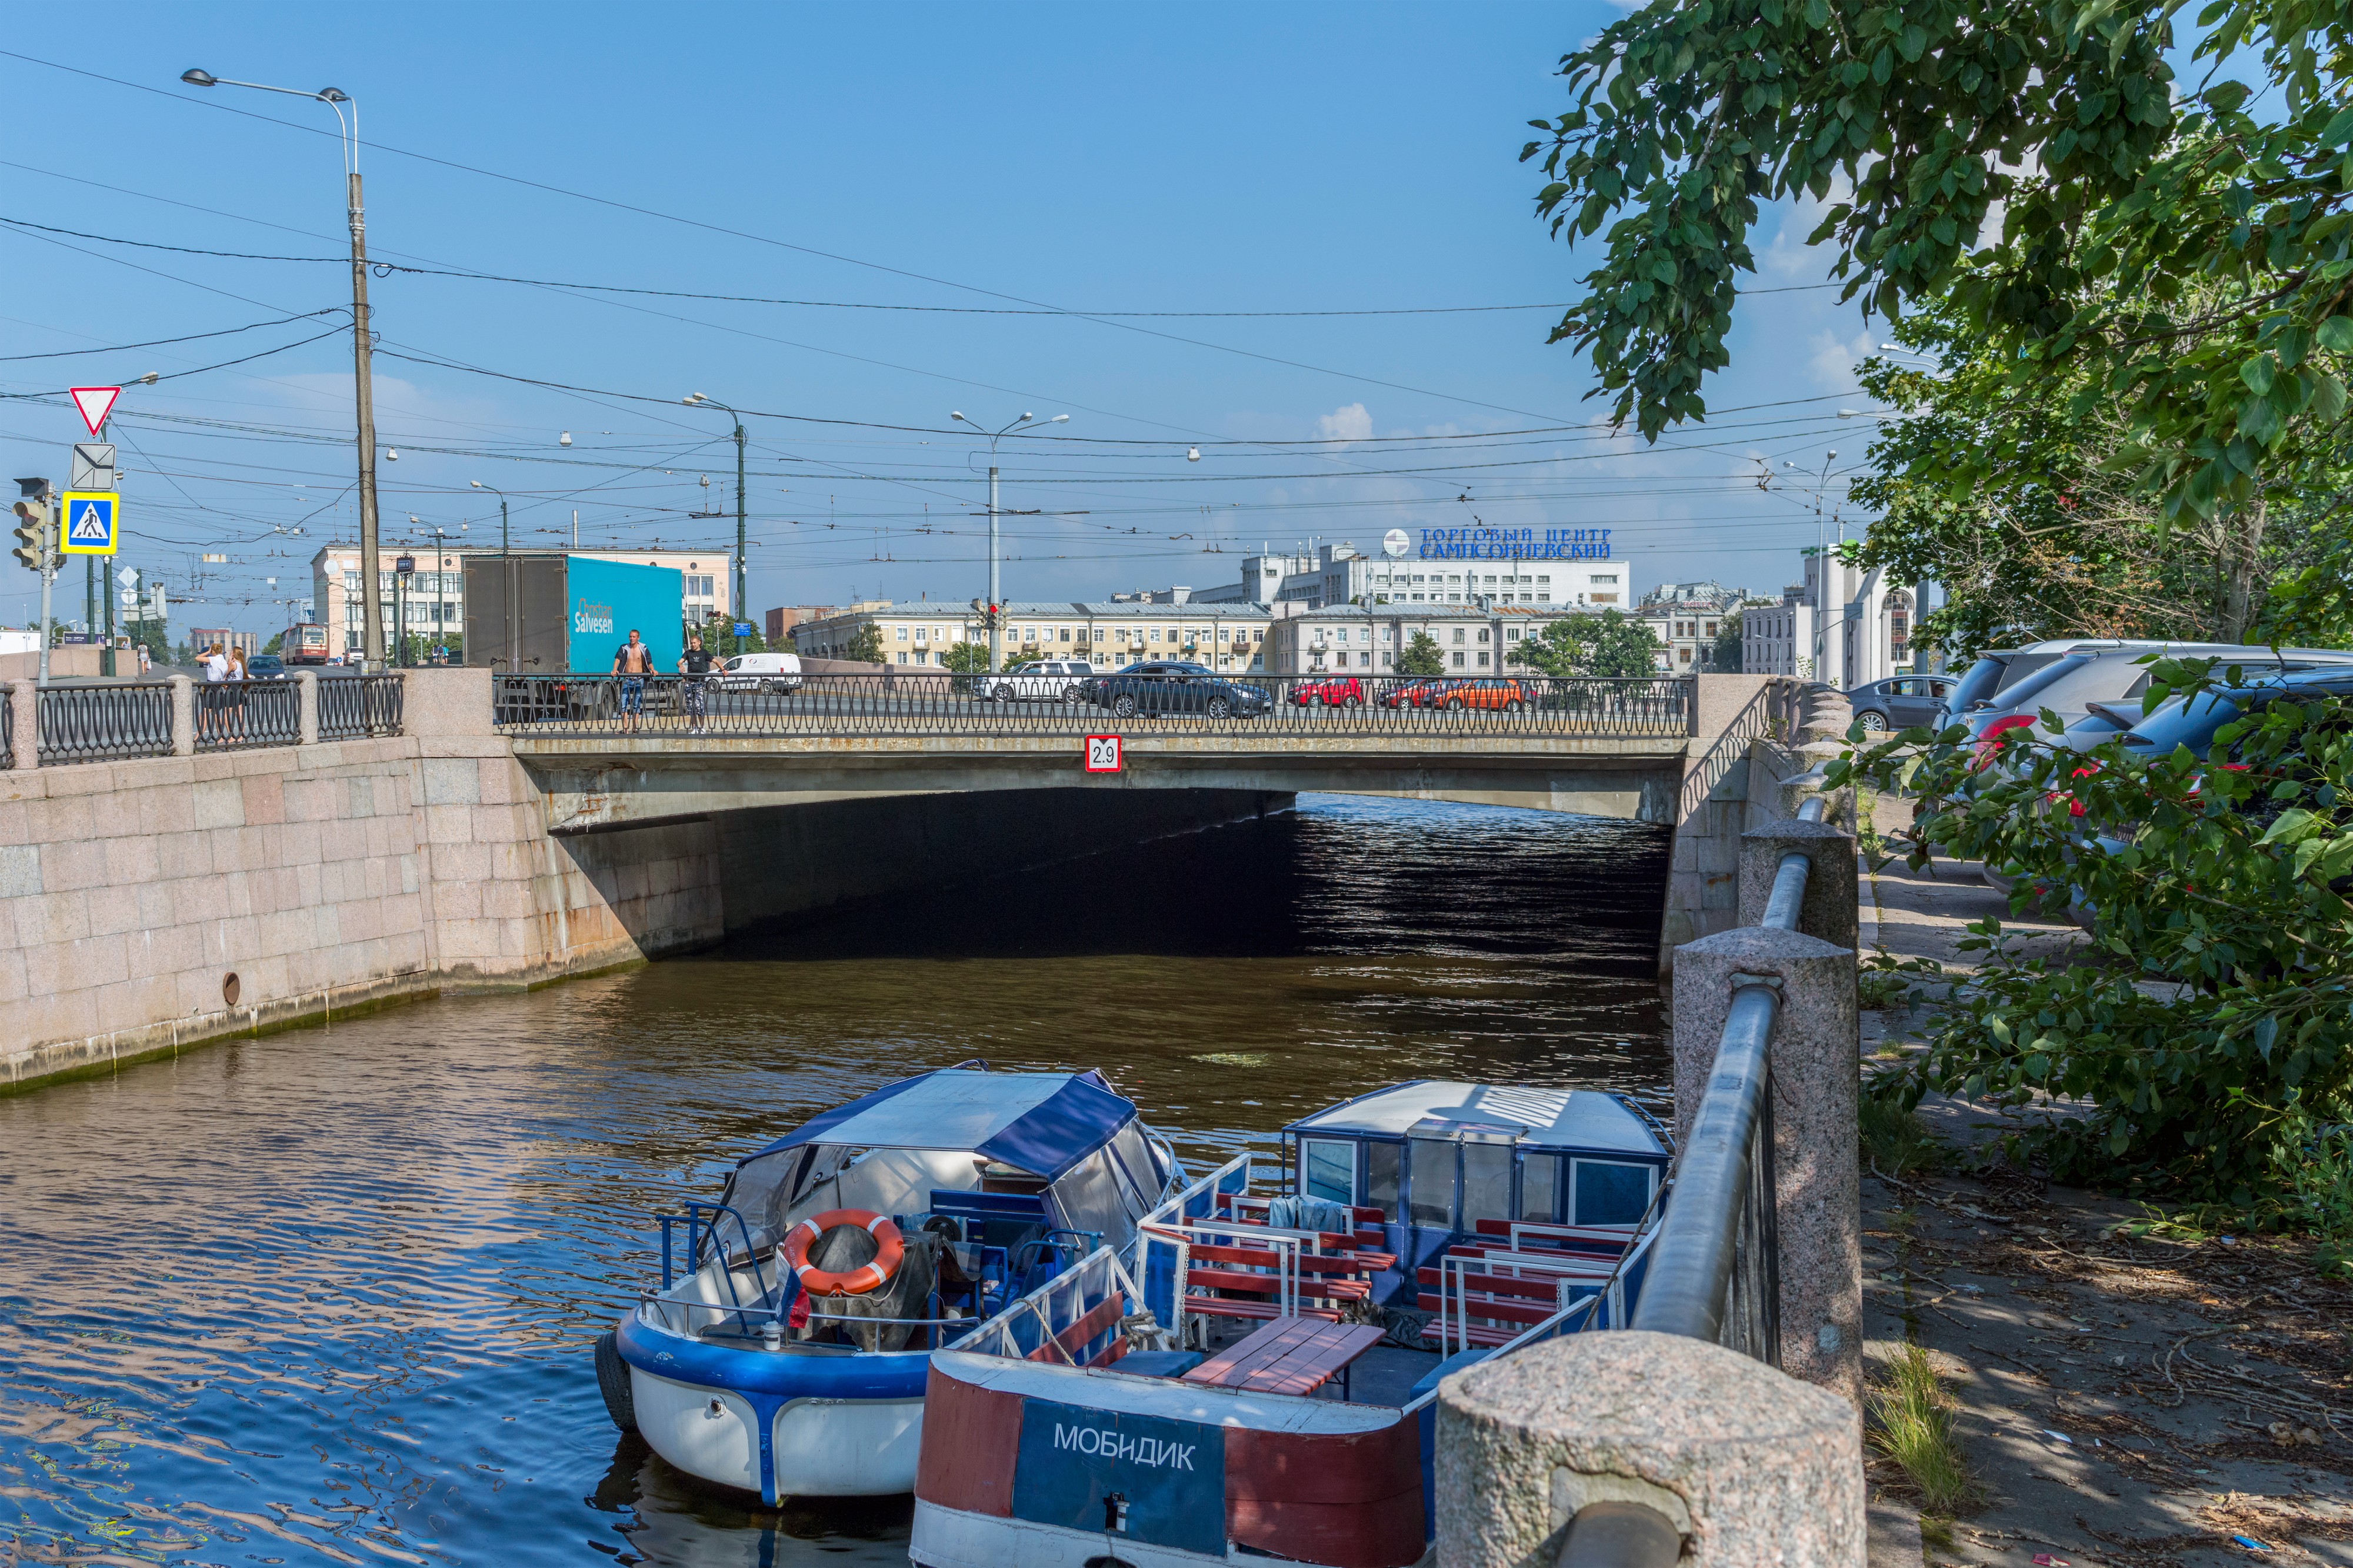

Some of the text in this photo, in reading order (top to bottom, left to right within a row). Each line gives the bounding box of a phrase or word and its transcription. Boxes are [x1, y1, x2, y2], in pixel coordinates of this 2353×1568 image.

[1419, 527, 1612, 542] ТОРГОВЫЙ ЦЕНТР
[1419, 541, 1611, 559] САМПСОНИЕВСКИЙ
[578, 597, 612, 619] Christian
[575, 611, 613, 634] Salvesen
[1093, 746, 1115, 763] 2.9
[1054, 1423, 1196, 1471] МОБИДИК
